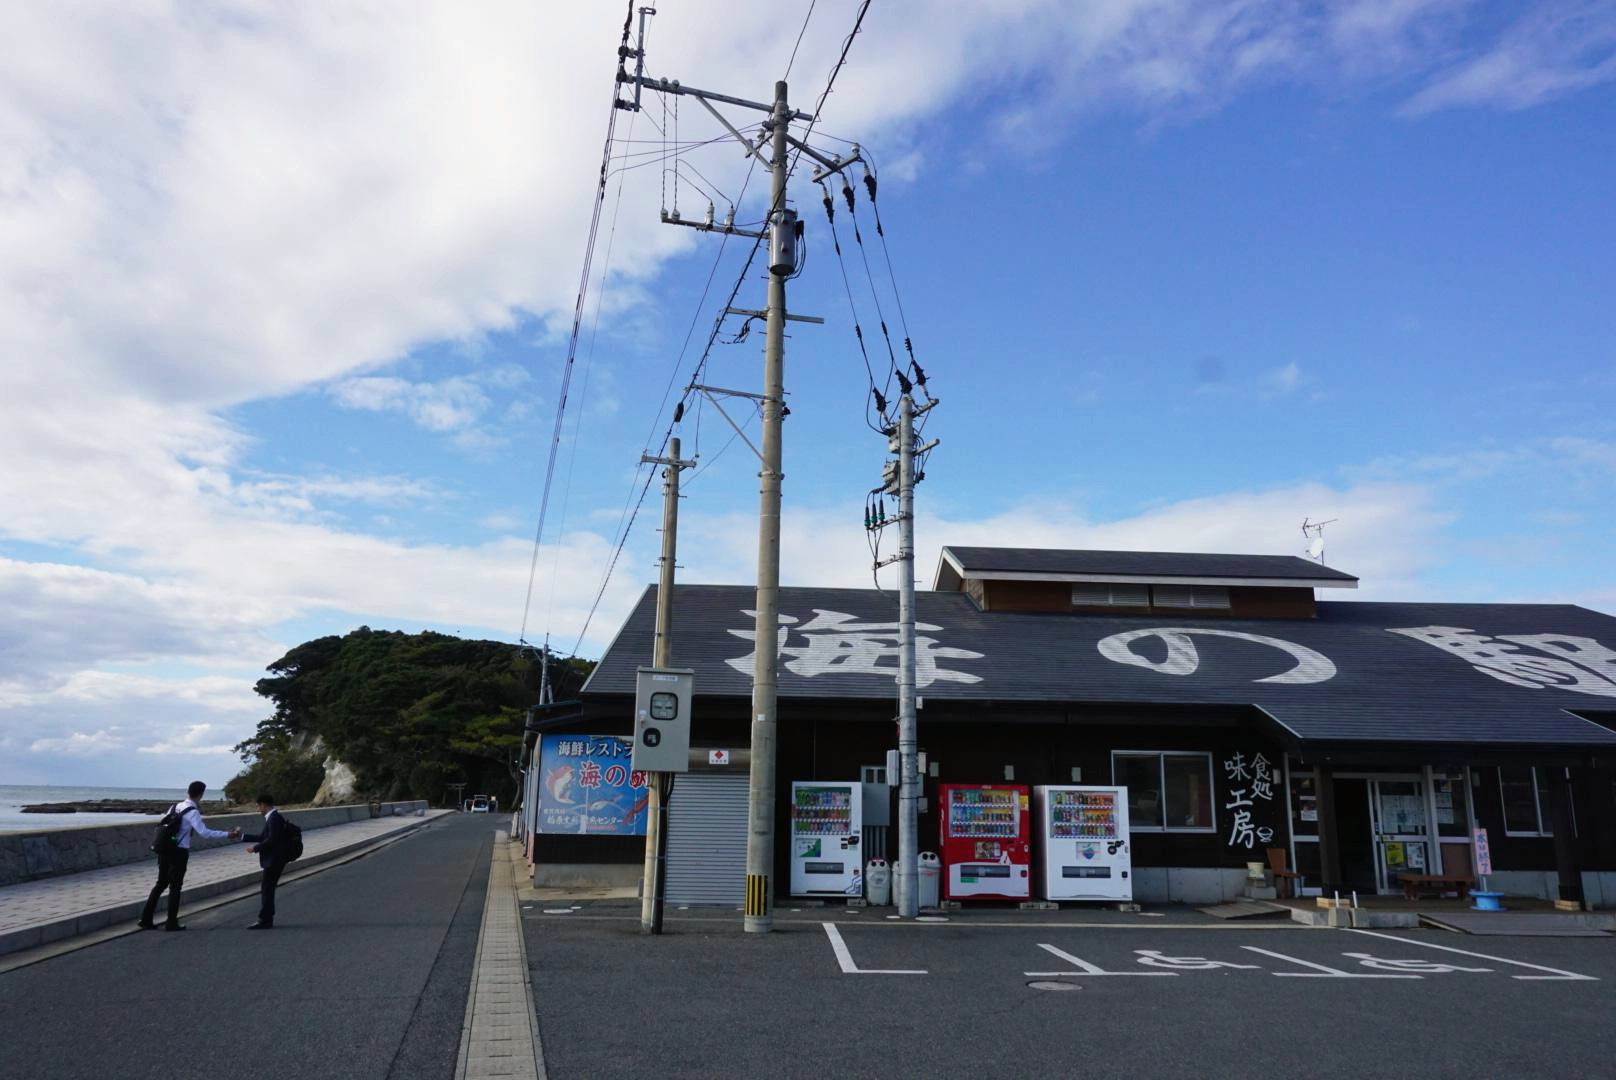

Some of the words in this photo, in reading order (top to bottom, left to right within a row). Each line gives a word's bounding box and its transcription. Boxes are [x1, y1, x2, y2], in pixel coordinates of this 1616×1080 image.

[1223, 751, 1255, 849] 味工房
[1247, 751, 1274, 801] 食処
